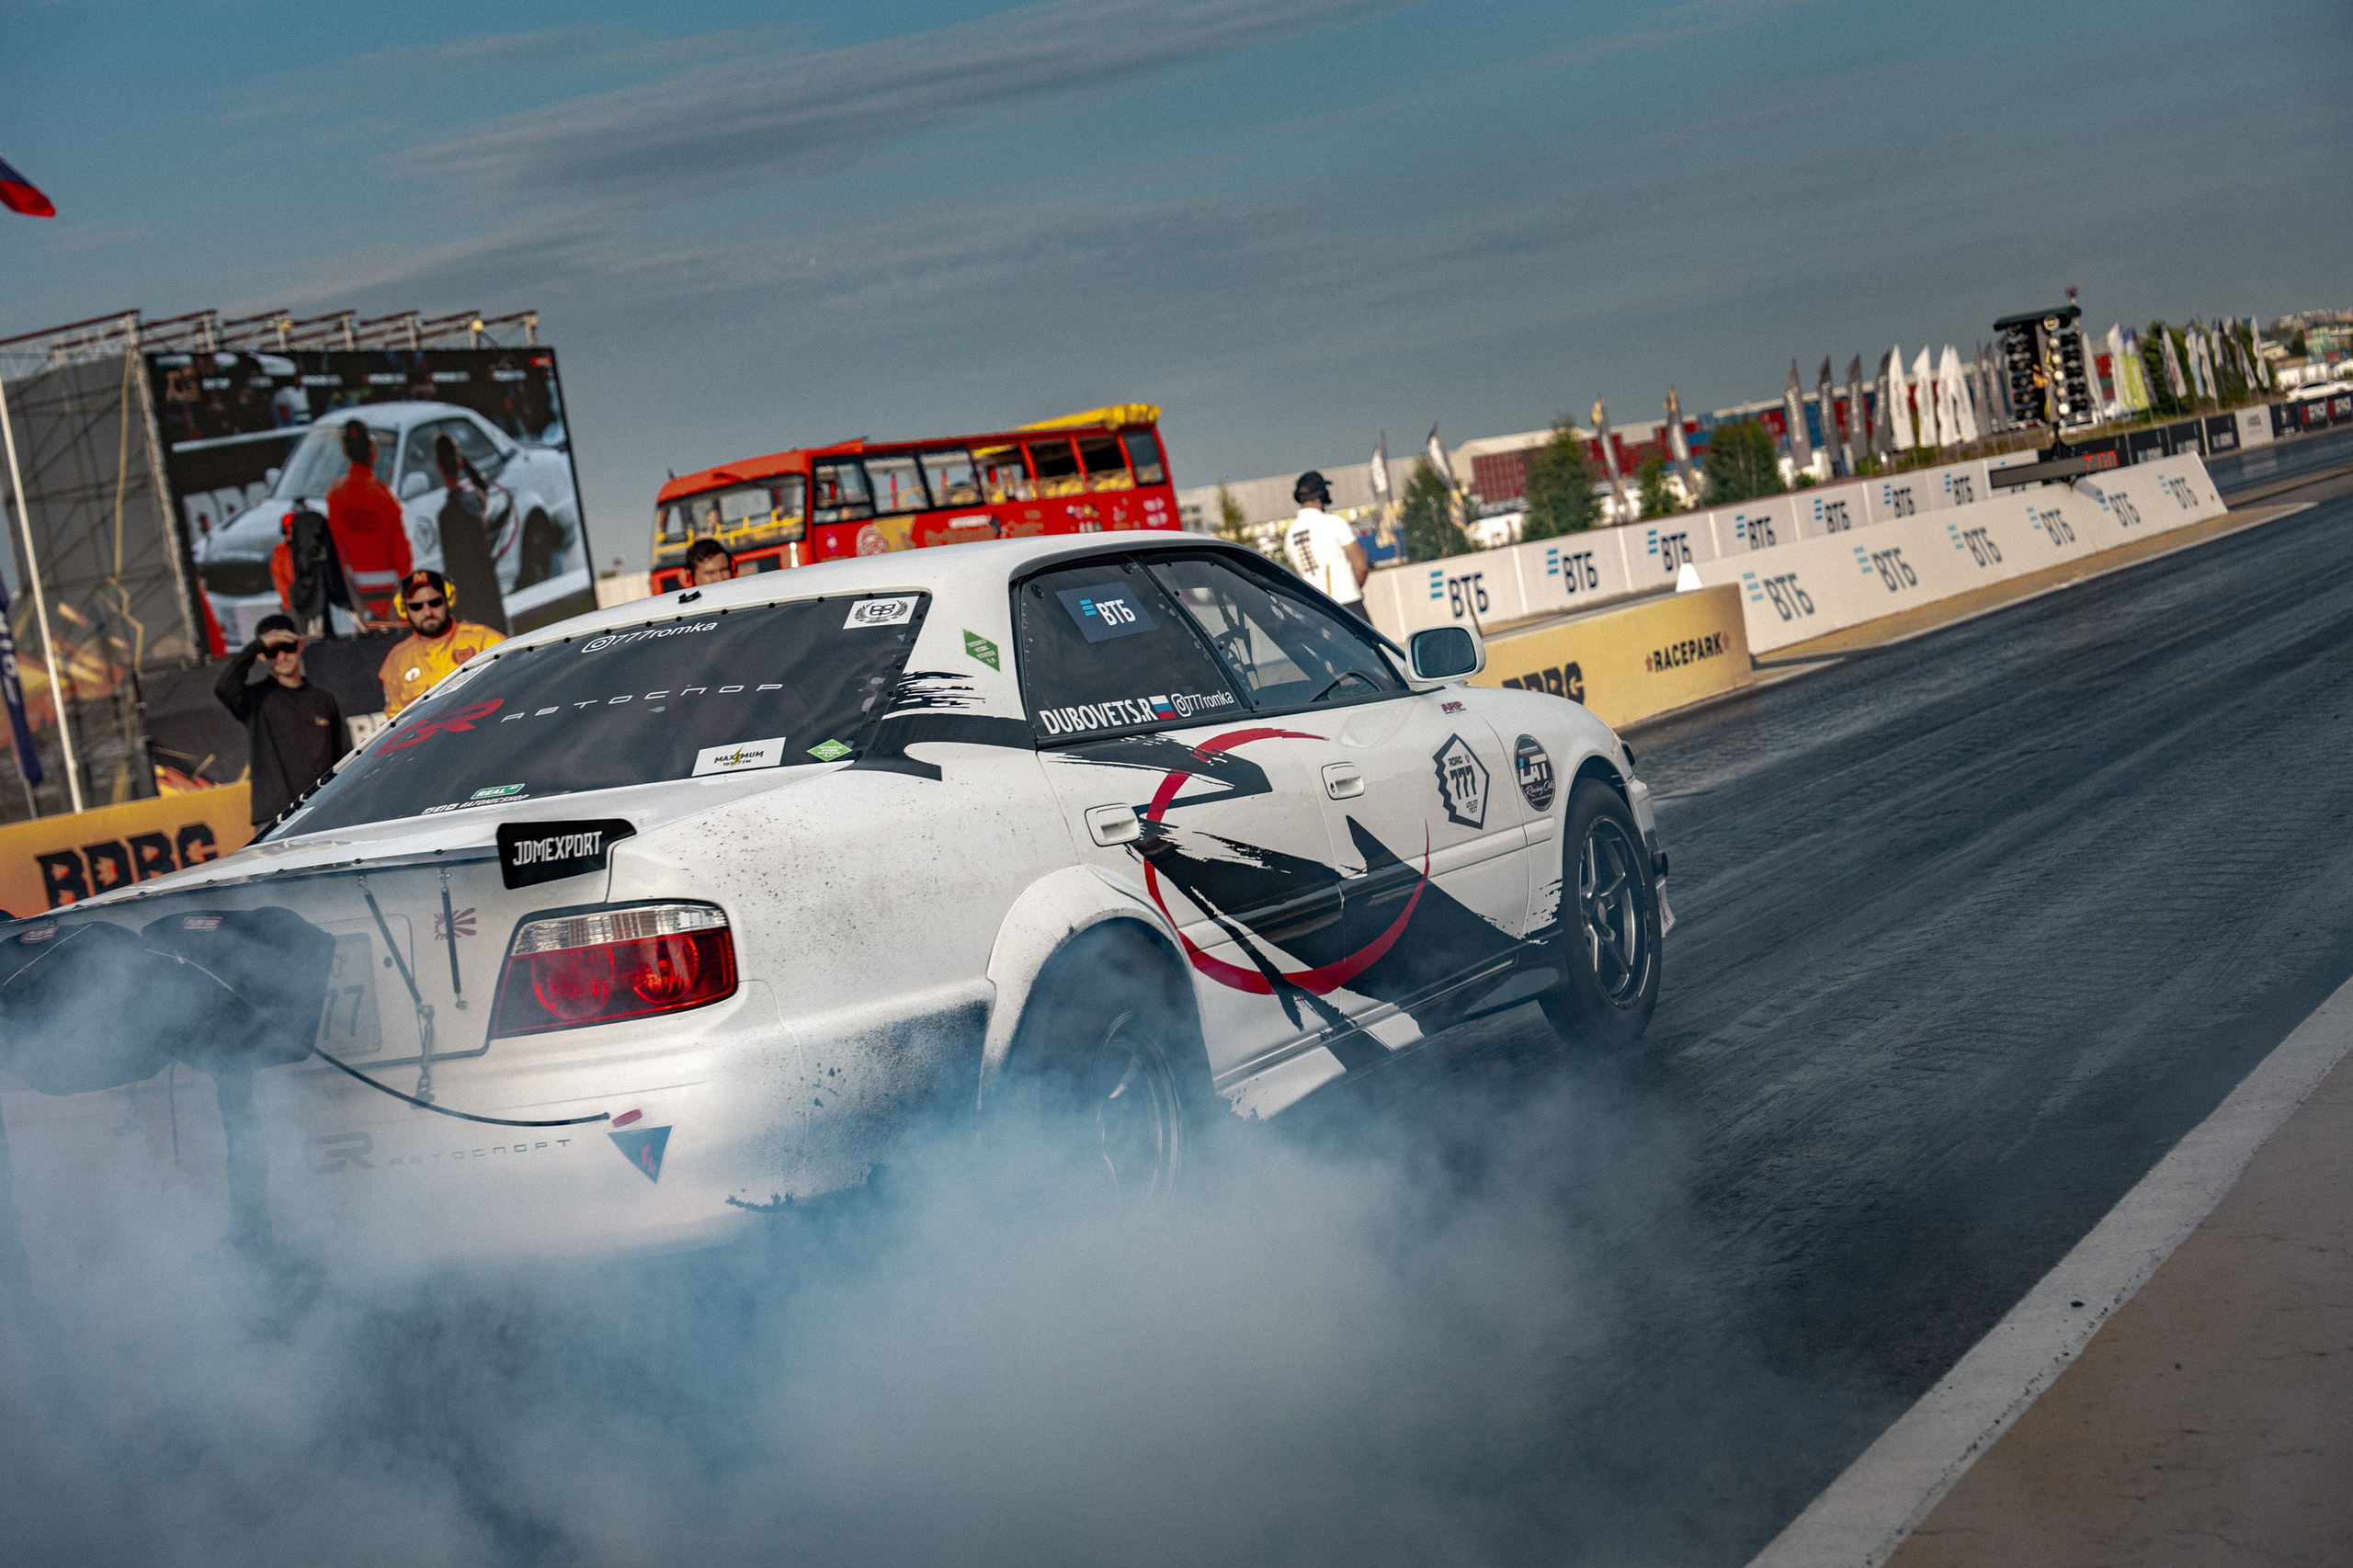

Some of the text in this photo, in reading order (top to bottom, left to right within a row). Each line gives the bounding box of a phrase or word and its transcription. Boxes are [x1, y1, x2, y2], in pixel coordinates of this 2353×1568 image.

[1747, 516, 1777, 550] ВТБ
[1824, 500, 1851, 533] ВТБ
[2040, 508, 2075, 546] ВТБ
[1962, 527, 2003, 567] ВТБ
[1563, 551, 1598, 593] ВТБ
[1871, 547, 1917, 592] ВТБ
[1096, 599, 1137, 627] ВТБ
[1448, 574, 1490, 618] ВТБ
[1763, 572, 1815, 621] ВТБ
[1653, 631, 1724, 673] RACEPARK
[1039, 697, 1159, 735] DUBOVETS.R
[1449, 765, 1477, 800] 777
[512, 831, 603, 866] JDMEXPORT
